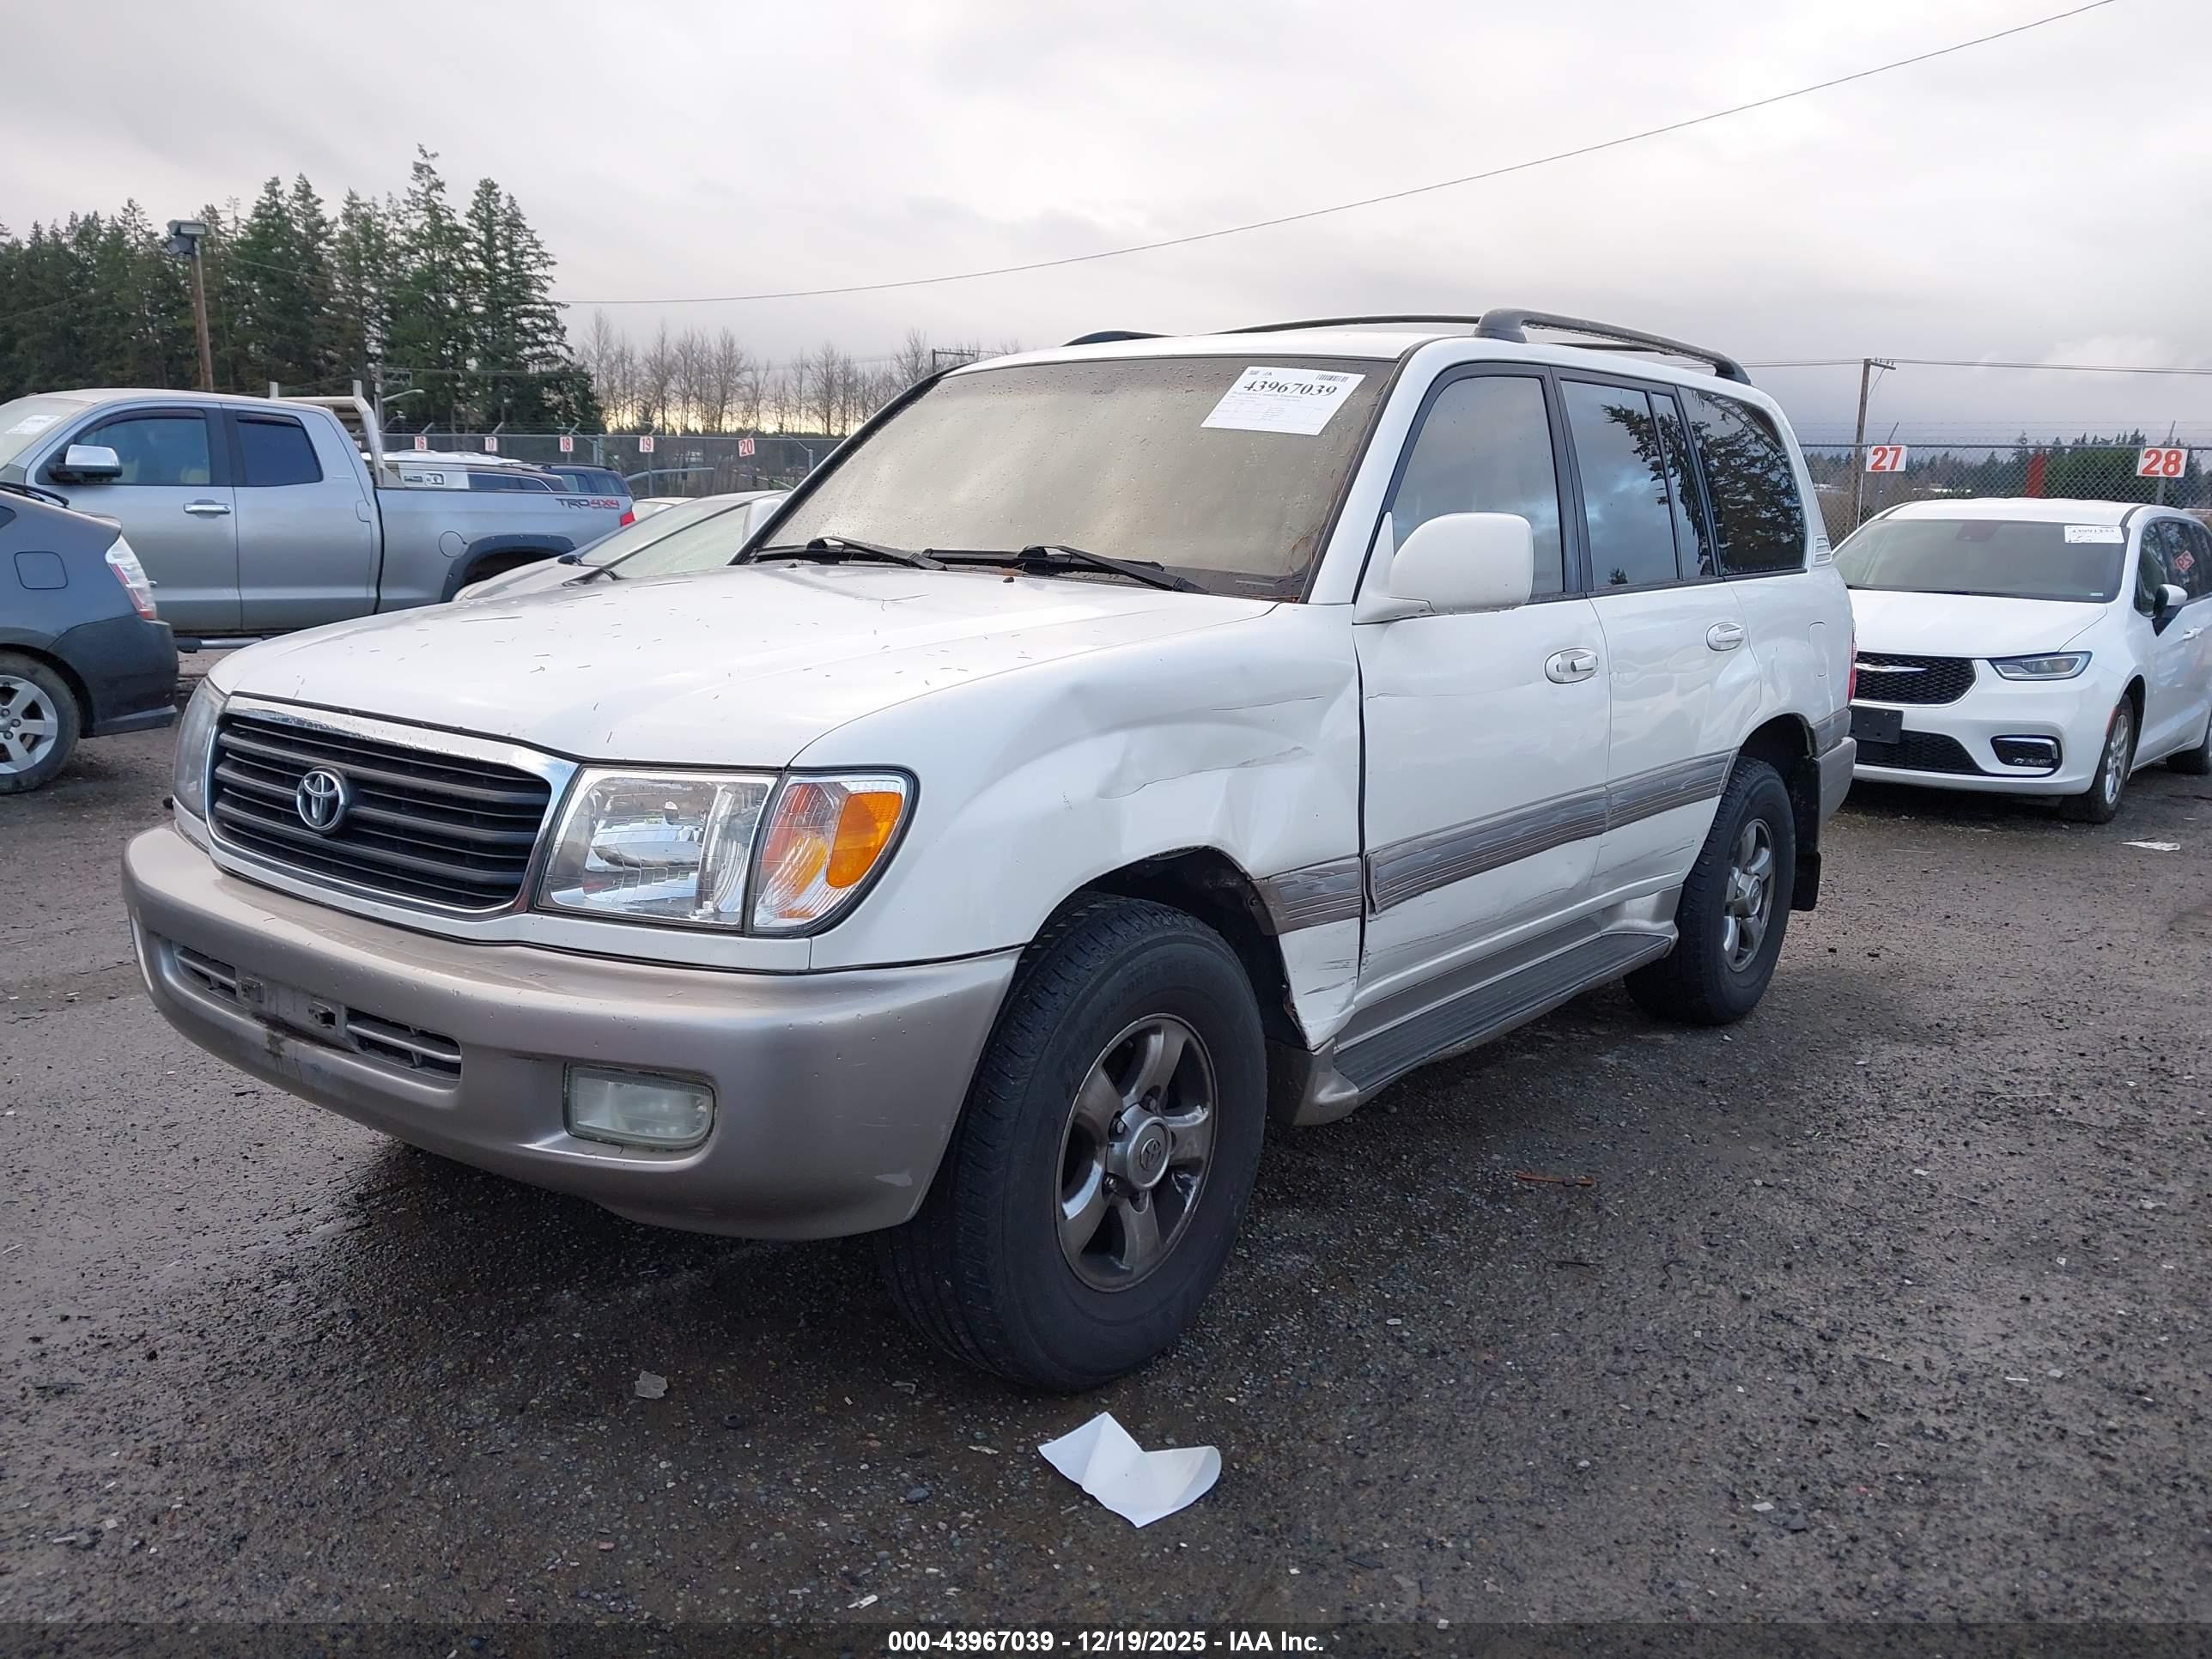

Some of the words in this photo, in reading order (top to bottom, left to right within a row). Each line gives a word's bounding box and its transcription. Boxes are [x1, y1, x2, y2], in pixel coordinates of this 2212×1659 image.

[1243, 380, 1338, 397] 43967039
[416, 437, 425, 449] 16
[487, 438, 495, 450] 17
[562, 438, 571, 451] 18
[642, 437, 652, 451] 19
[741, 439, 754, 455] 20
[1870, 446, 1903, 471] 27
[2142, 448, 2183, 477] 28
